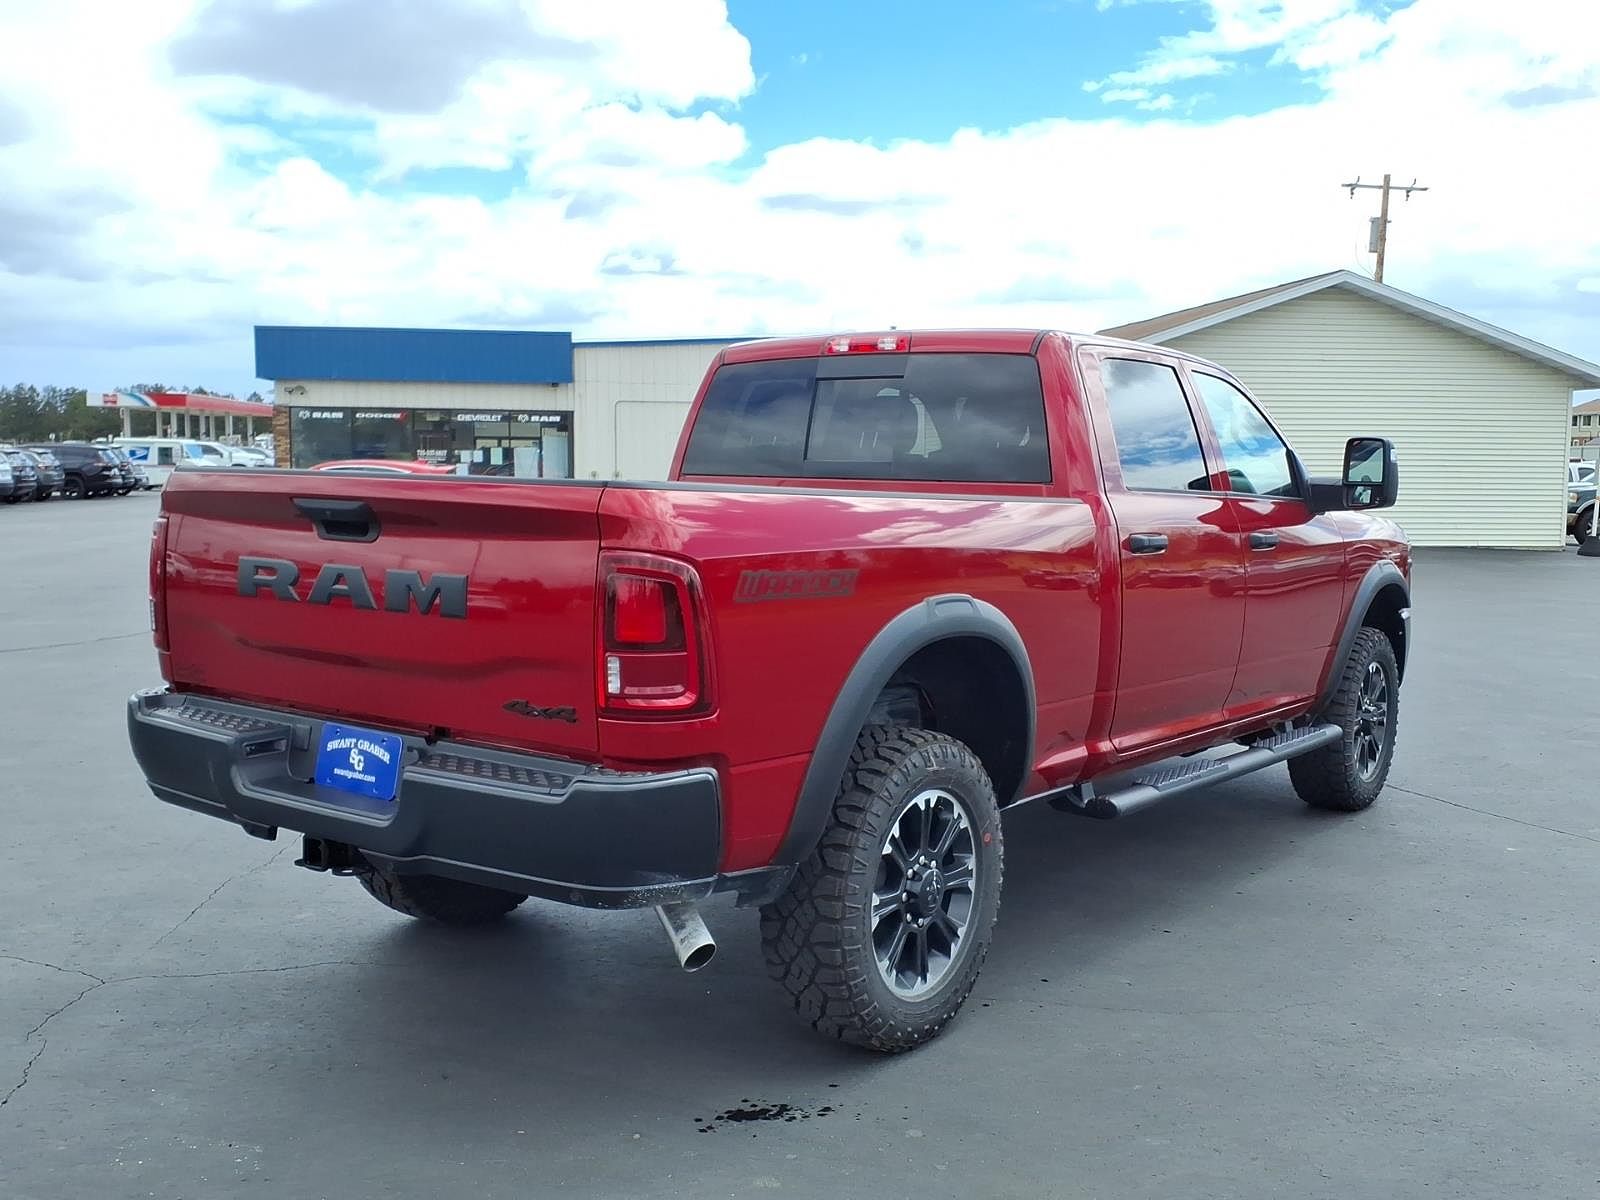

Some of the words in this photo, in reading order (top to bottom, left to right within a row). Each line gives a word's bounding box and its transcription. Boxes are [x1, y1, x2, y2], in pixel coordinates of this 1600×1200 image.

[311, 411, 344, 419] RAM
[457, 413, 503, 422] CHEVROLET
[238, 555, 469, 619] RAM
[326, 737, 357, 752] SWANT
[357, 739, 391, 765] GRABER
